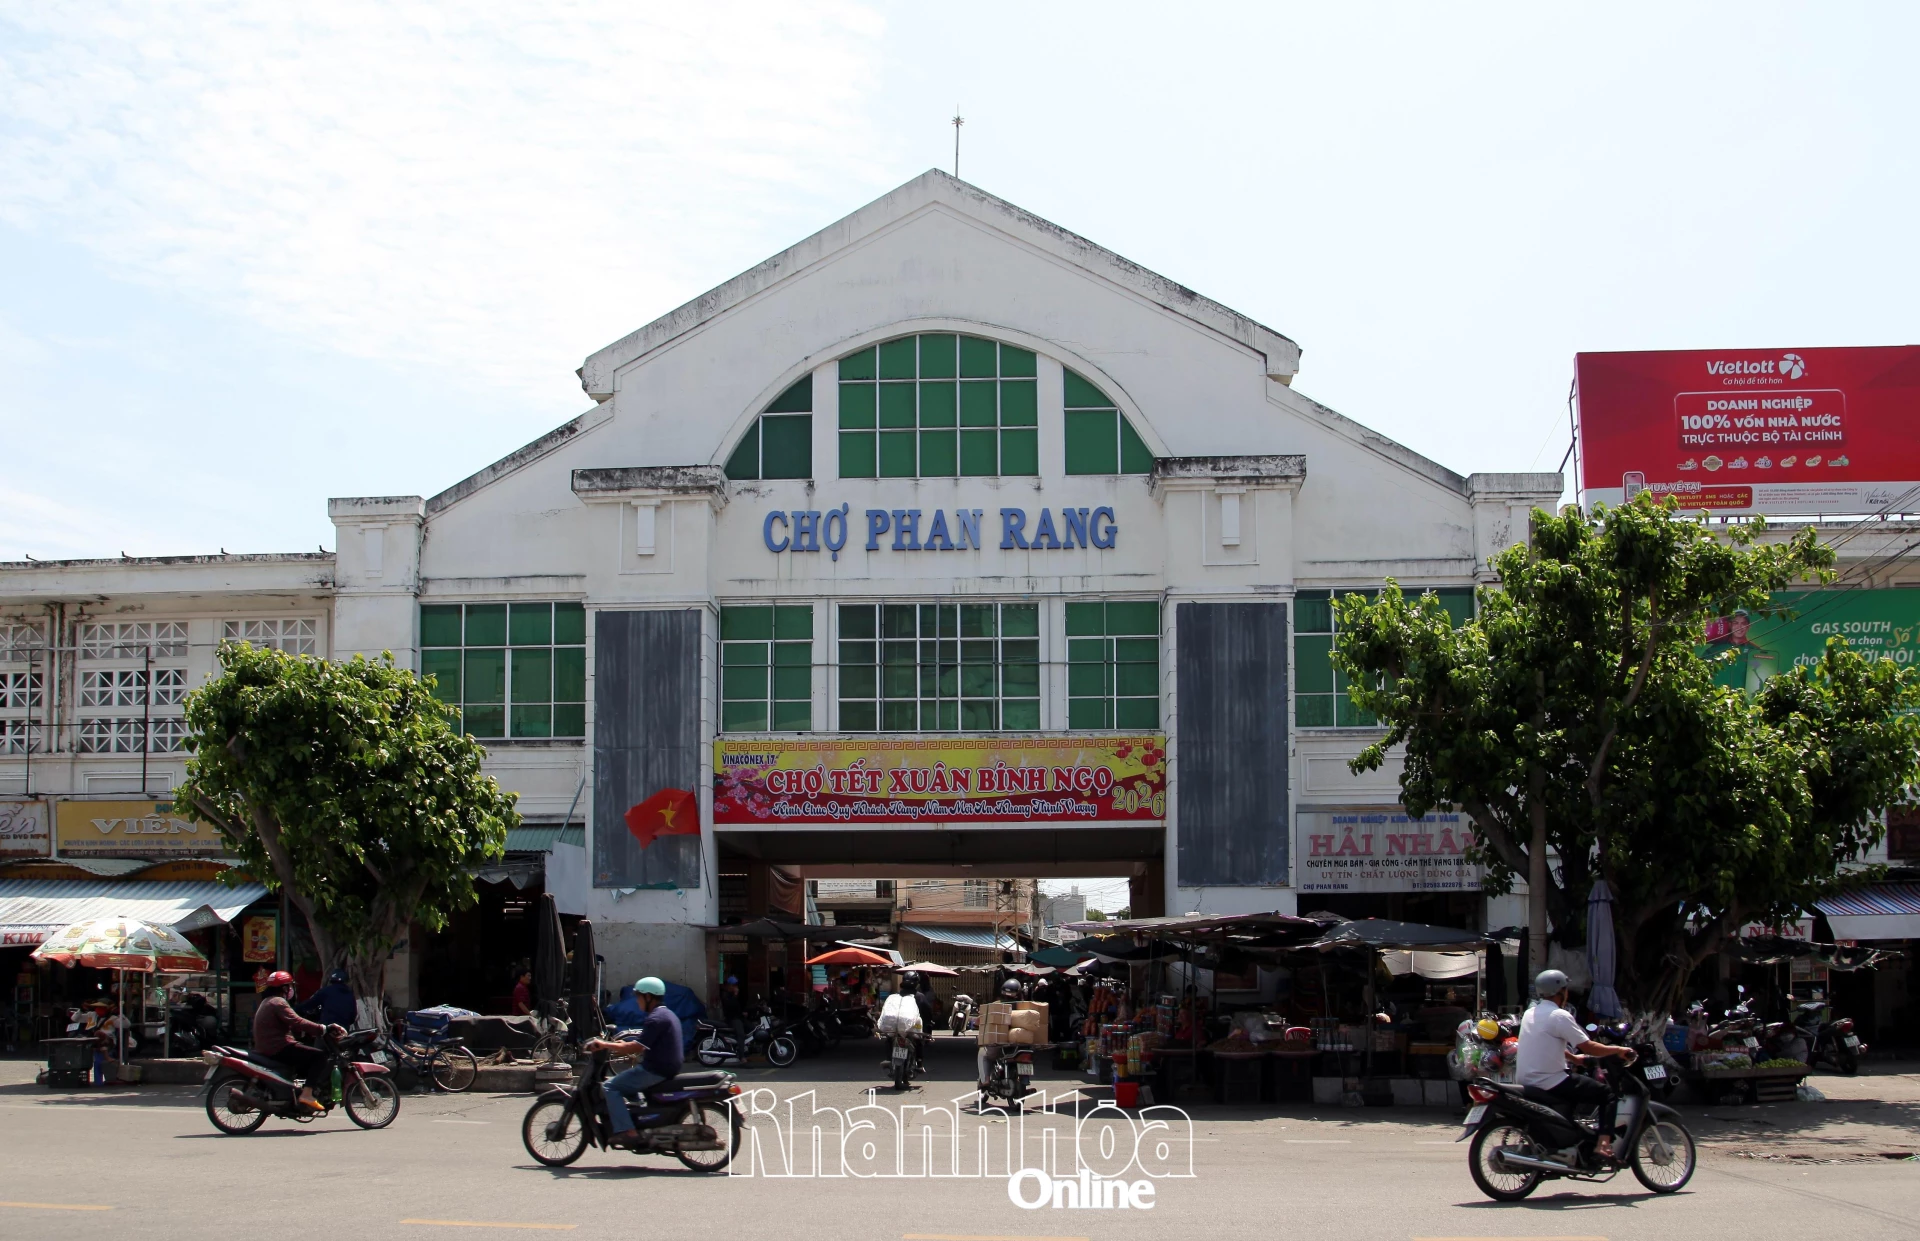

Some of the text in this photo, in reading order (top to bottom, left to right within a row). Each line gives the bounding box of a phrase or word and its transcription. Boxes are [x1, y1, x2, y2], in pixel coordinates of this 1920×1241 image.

[1706, 360, 1774, 375] Vietlott
[1734, 377, 1746, 386] hội
[1747, 376, 1756, 384] để
[1707, 396, 1813, 411] DOANH NGHIỆP
[1681, 413, 1841, 430] 100% VỐN NHÀ NƯỚC
[1682, 429, 1842, 446] TRỰC THUỘC BỘ TÀI CHÍNH
[1646, 483, 1669, 493] MUA
[1685, 482, 1701, 494] TẠI
[764, 502, 1118, 562] CHỢ PHAN RANG
[1811, 621, 1891, 634] GAS SOUTH
[1858, 636, 1882, 647] chọn
[1794, 653, 1818, 666] cho
[722, 754, 776, 765] VINACONEX 17
[766, 758, 1114, 799] CHỢ TẾT XUÂN BÍNH NGỌ
[1112, 784, 1166, 817] 2026
[802, 801, 827, 816] Chúc
[851, 800, 887, 816] Khách
[888, 800, 918, 819] Hàng
[919, 799, 948, 815] Năm
[950, 800, 973, 815] Mới
[973, 801, 993, 815] An
[994, 799, 1030, 819] Khang
[1032, 797, 1063, 816] Thịnh
[1062, 797, 1097, 817] Vượng
[1332, 815, 1358, 824] DOANH
[1309, 826, 1478, 856] HẢI NHÂN
[1306, 859, 1332, 868] CHUYÊN
[1350, 859, 1364, 867] BÁN
[1382, 858, 1399, 867] CÔNG
[1337, 870, 1352, 878] TÍN
[1360, 868, 1385, 878] CHẤT
[1388, 868, 1419, 879] LƯỢNG
[1455, 867, 1471, 877] GIÁ
[2, 933, 44, 945] KIM
